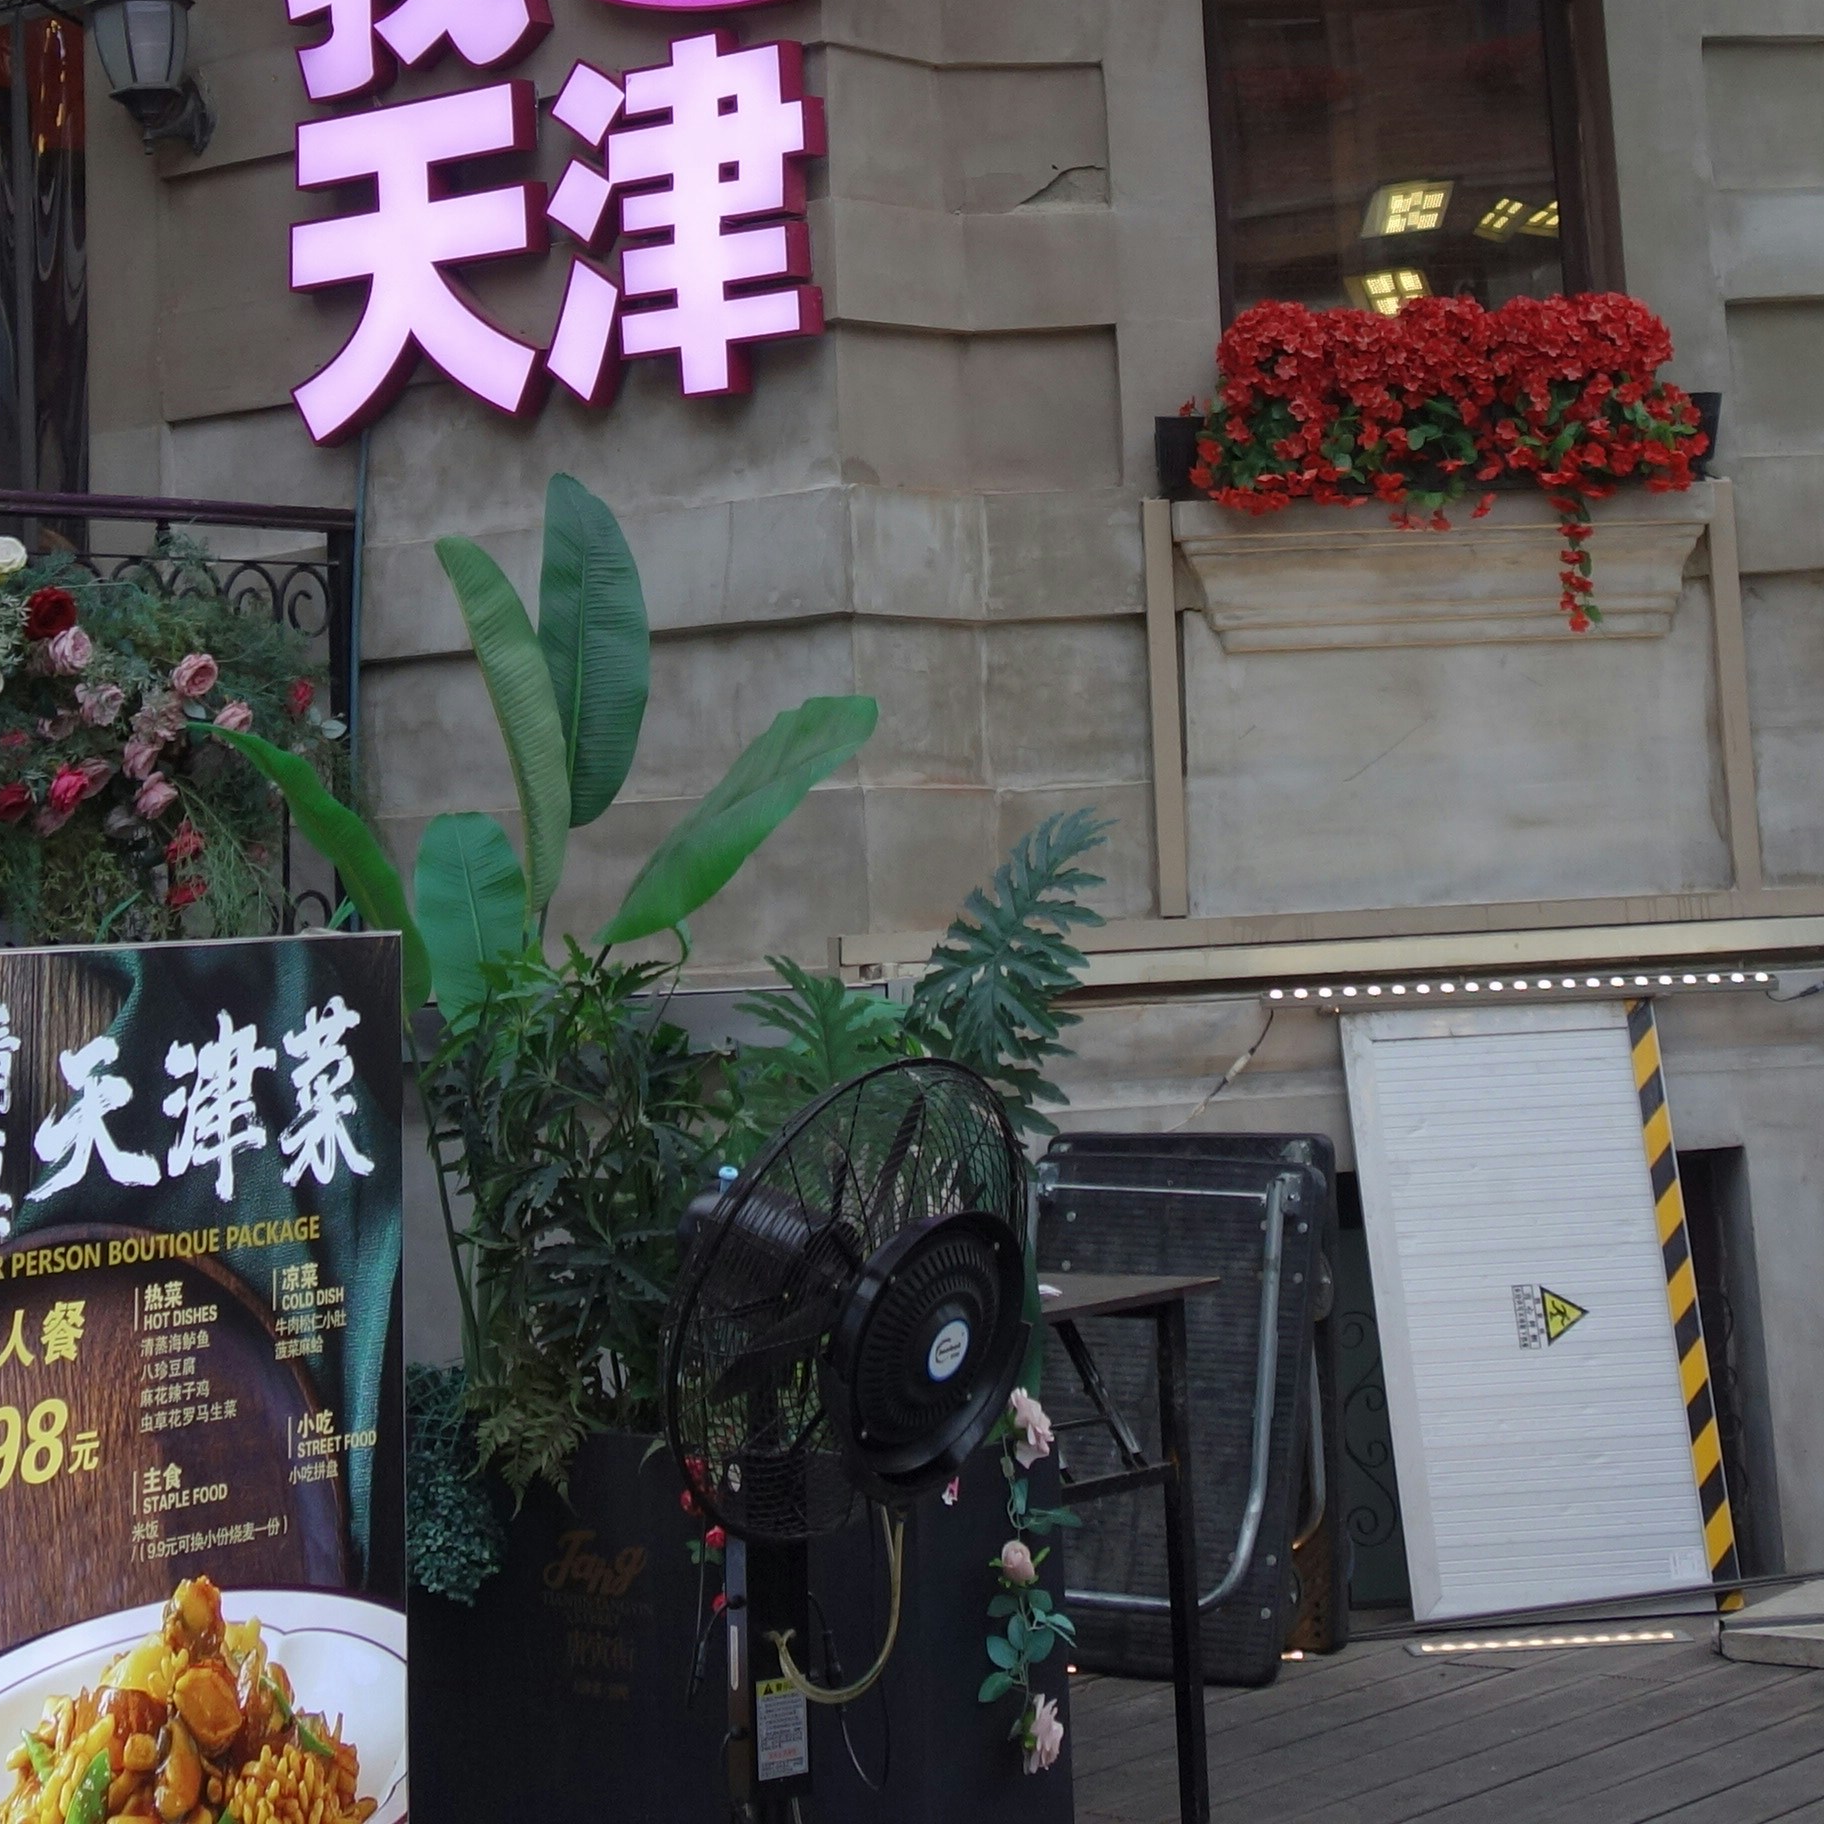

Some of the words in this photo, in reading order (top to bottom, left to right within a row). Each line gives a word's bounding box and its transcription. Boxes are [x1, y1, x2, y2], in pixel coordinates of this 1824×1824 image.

[289, 26, 821, 445] 天津
[24, 994, 376, 1203] 天津菜
[12, 1242, 102, 1280] PERSON
[108, 1225, 220, 1264] BOUTIQUE
[226, 1215, 321, 1250] PACKAGE
[281, 1262, 319, 1292] 凉菜
[144, 1280, 184, 1312] 热菜
[281, 1293, 315, 1312] COLD
[316, 1286, 345, 1307] DISH
[143, 1310, 170, 1332] HOT
[172, 1303, 219, 1327] DISHES
[139, 1329, 211, 1358] 清蒸海鲈鱼
[139, 1356, 196, 1382] 八珍豆腐
[139, 1379, 211, 1409] 麻花辣子鸡
[139, 1399, 238, 1434] 虫草花罗马生菜
[296, 1409, 335, 1439] 小吃
[297, 1434, 343, 1460] STREET
[344, 1430, 378, 1450] FOOD
[142, 1462, 183, 1495] 主食
[288, 1458, 339, 1486] 小吃拼盘
[143, 1489, 190, 1515] STAPLE
[192, 1483, 228, 1506] FOOD
[131, 1519, 160, 1543] 米饭
